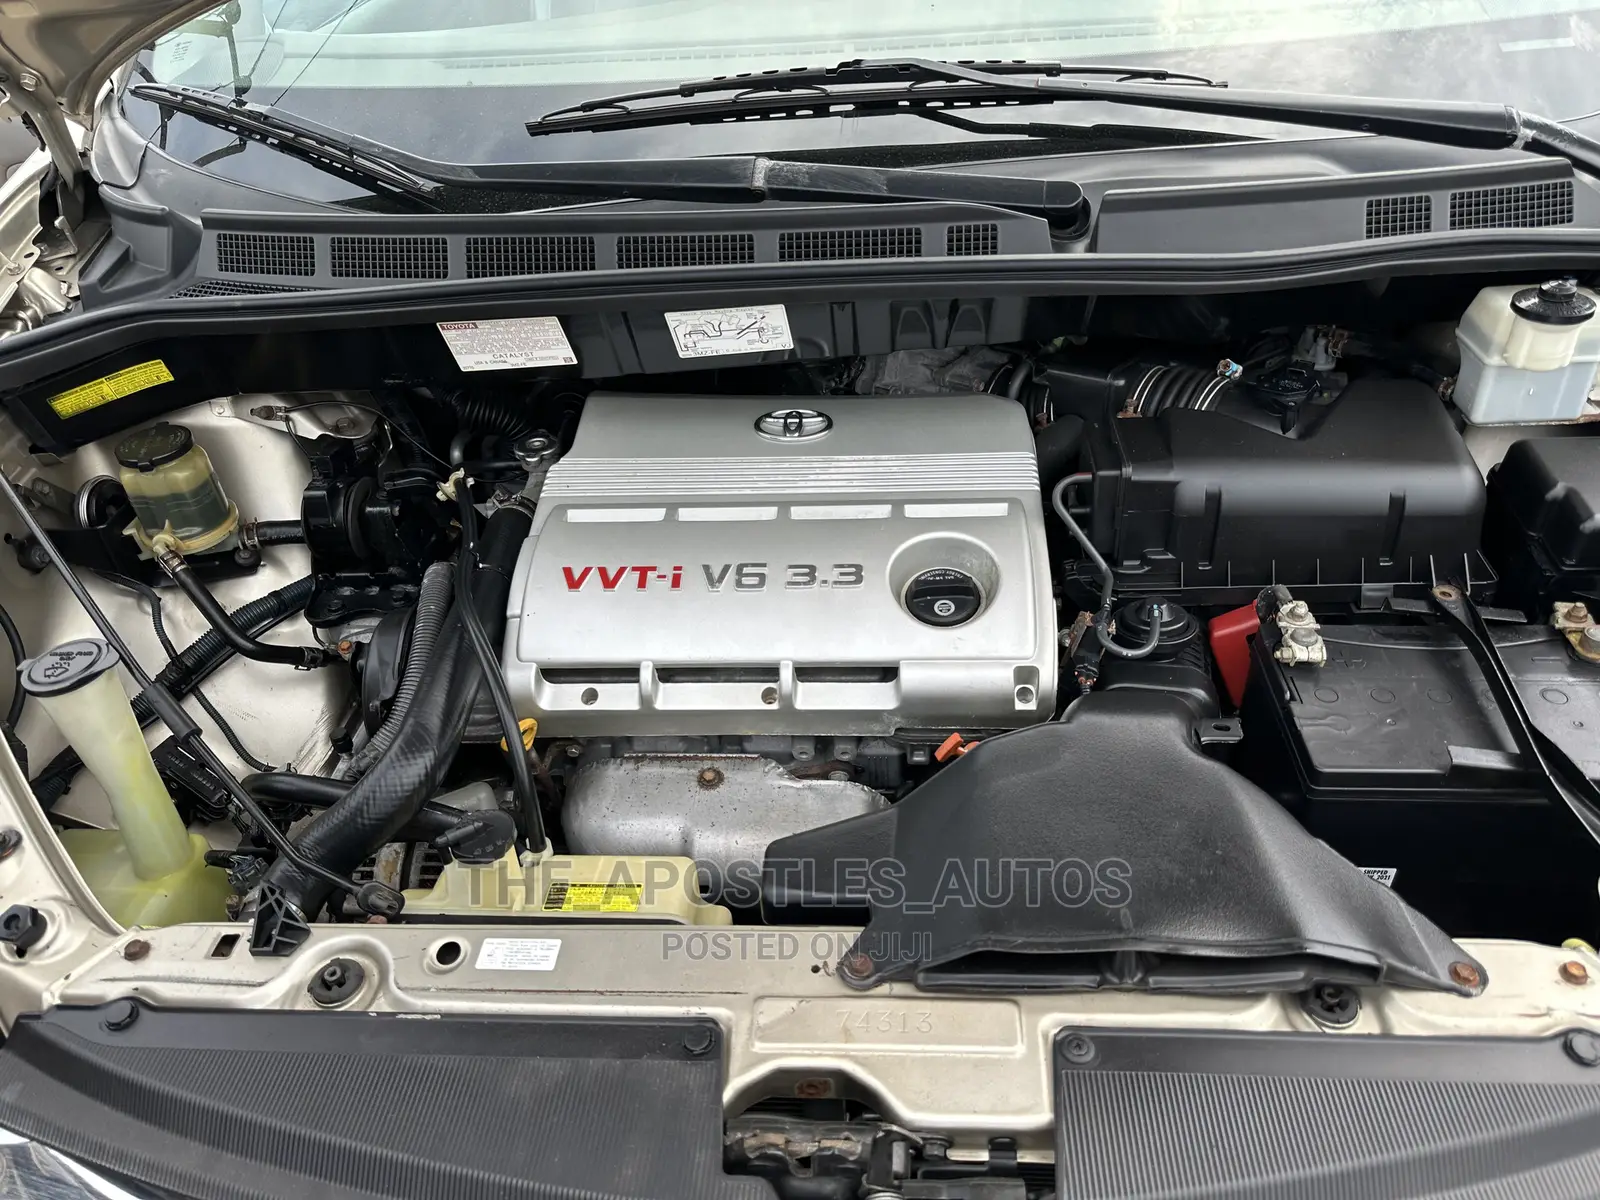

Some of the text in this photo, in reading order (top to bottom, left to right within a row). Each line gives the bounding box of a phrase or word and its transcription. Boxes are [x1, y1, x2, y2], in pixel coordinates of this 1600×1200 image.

[492, 351, 534, 359] CATALYST
[561, 563, 864, 592] VVT-i V6 3.3
[836, 1009, 932, 1033] 74313
